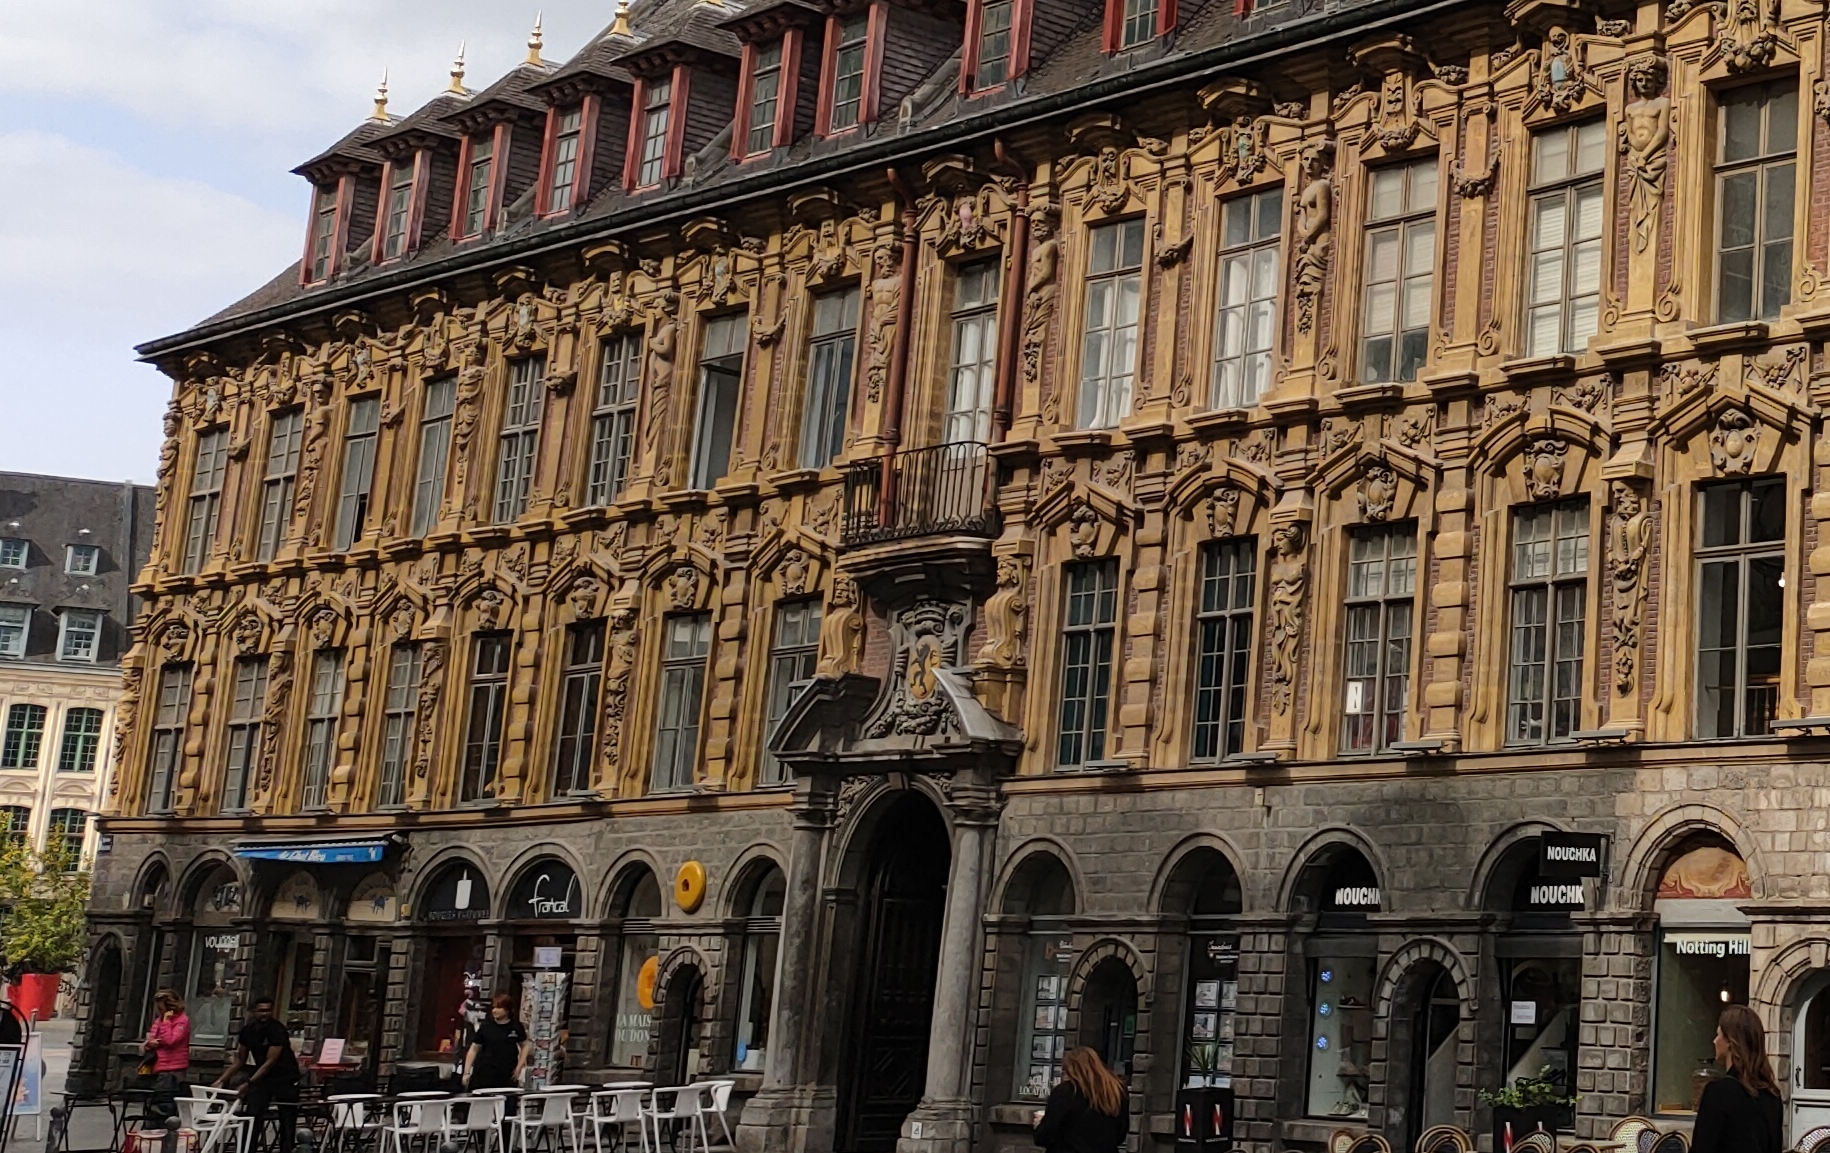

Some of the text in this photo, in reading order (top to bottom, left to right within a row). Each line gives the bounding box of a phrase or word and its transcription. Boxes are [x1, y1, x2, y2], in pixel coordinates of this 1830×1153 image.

[1547, 846, 1597, 862] NOUCHKA
[1676, 939, 1750, 958] Notting Hill
